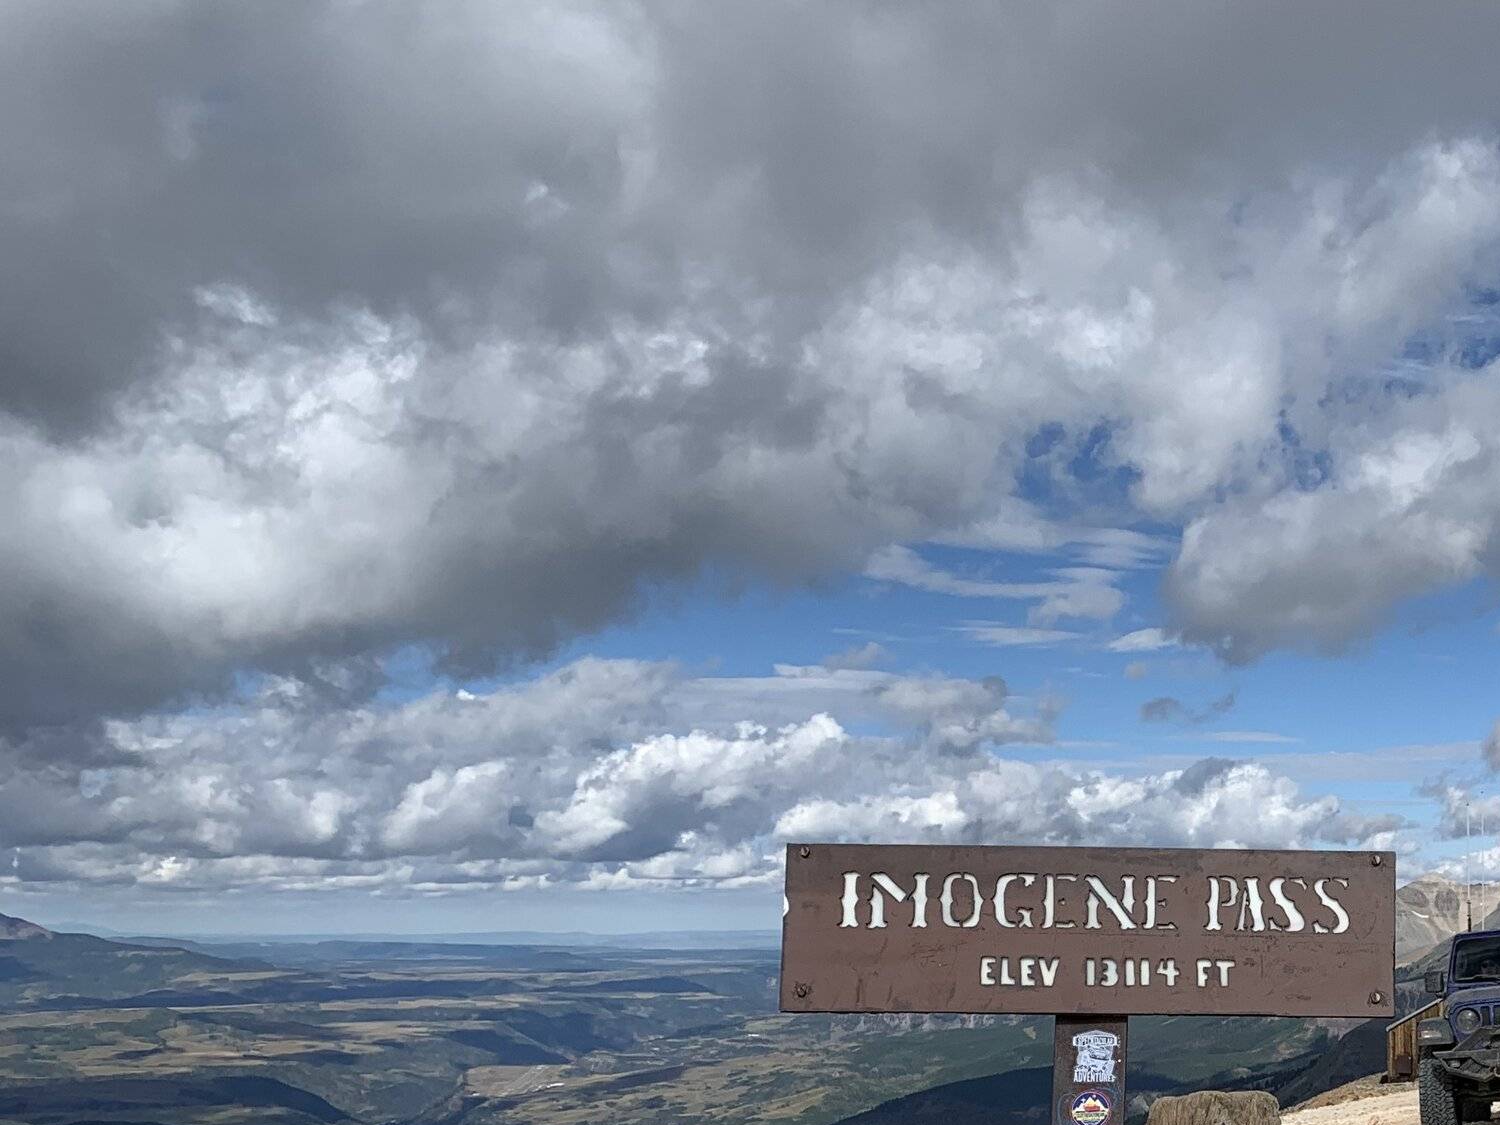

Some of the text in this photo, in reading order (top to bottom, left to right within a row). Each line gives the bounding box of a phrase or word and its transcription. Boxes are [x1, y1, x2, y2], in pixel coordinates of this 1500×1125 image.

[841, 871, 1351, 934] IMOGENE PASS
[980, 957, 1236, 987] ELEV 13114 FT
